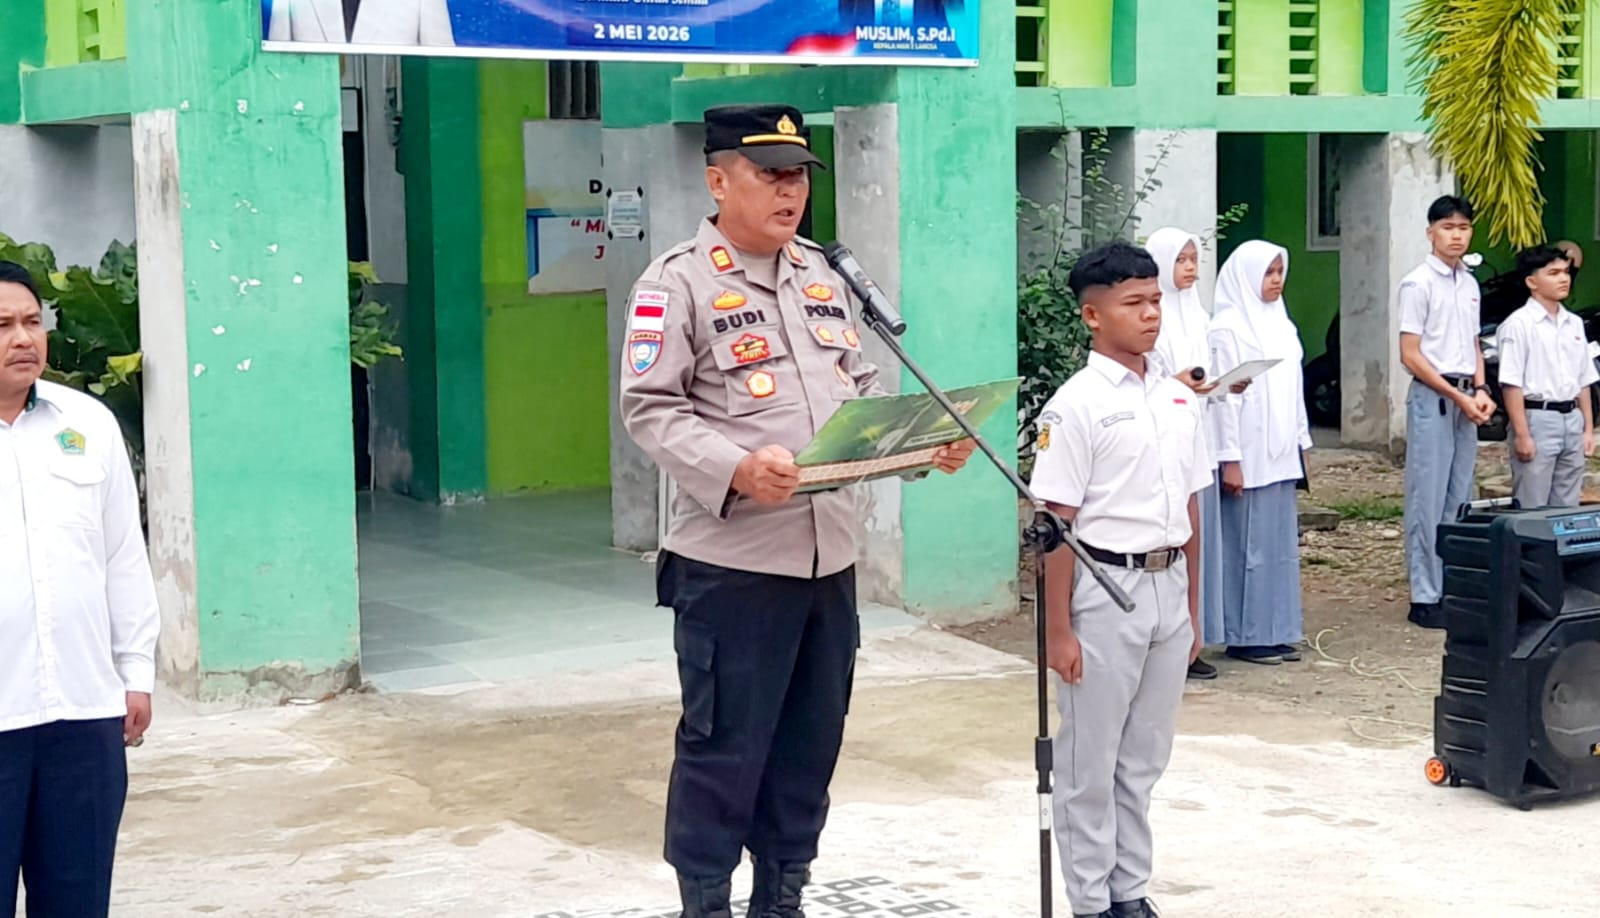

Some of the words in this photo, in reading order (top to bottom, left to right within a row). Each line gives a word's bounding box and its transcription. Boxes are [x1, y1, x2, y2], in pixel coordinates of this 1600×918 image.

[594, 23, 605, 39] 2
[609, 24, 642, 40] MEI
[647, 25, 690, 41] 2026
[855, 25, 914, 43] MUSLIM,
[713, 309, 766, 333] BUDI
